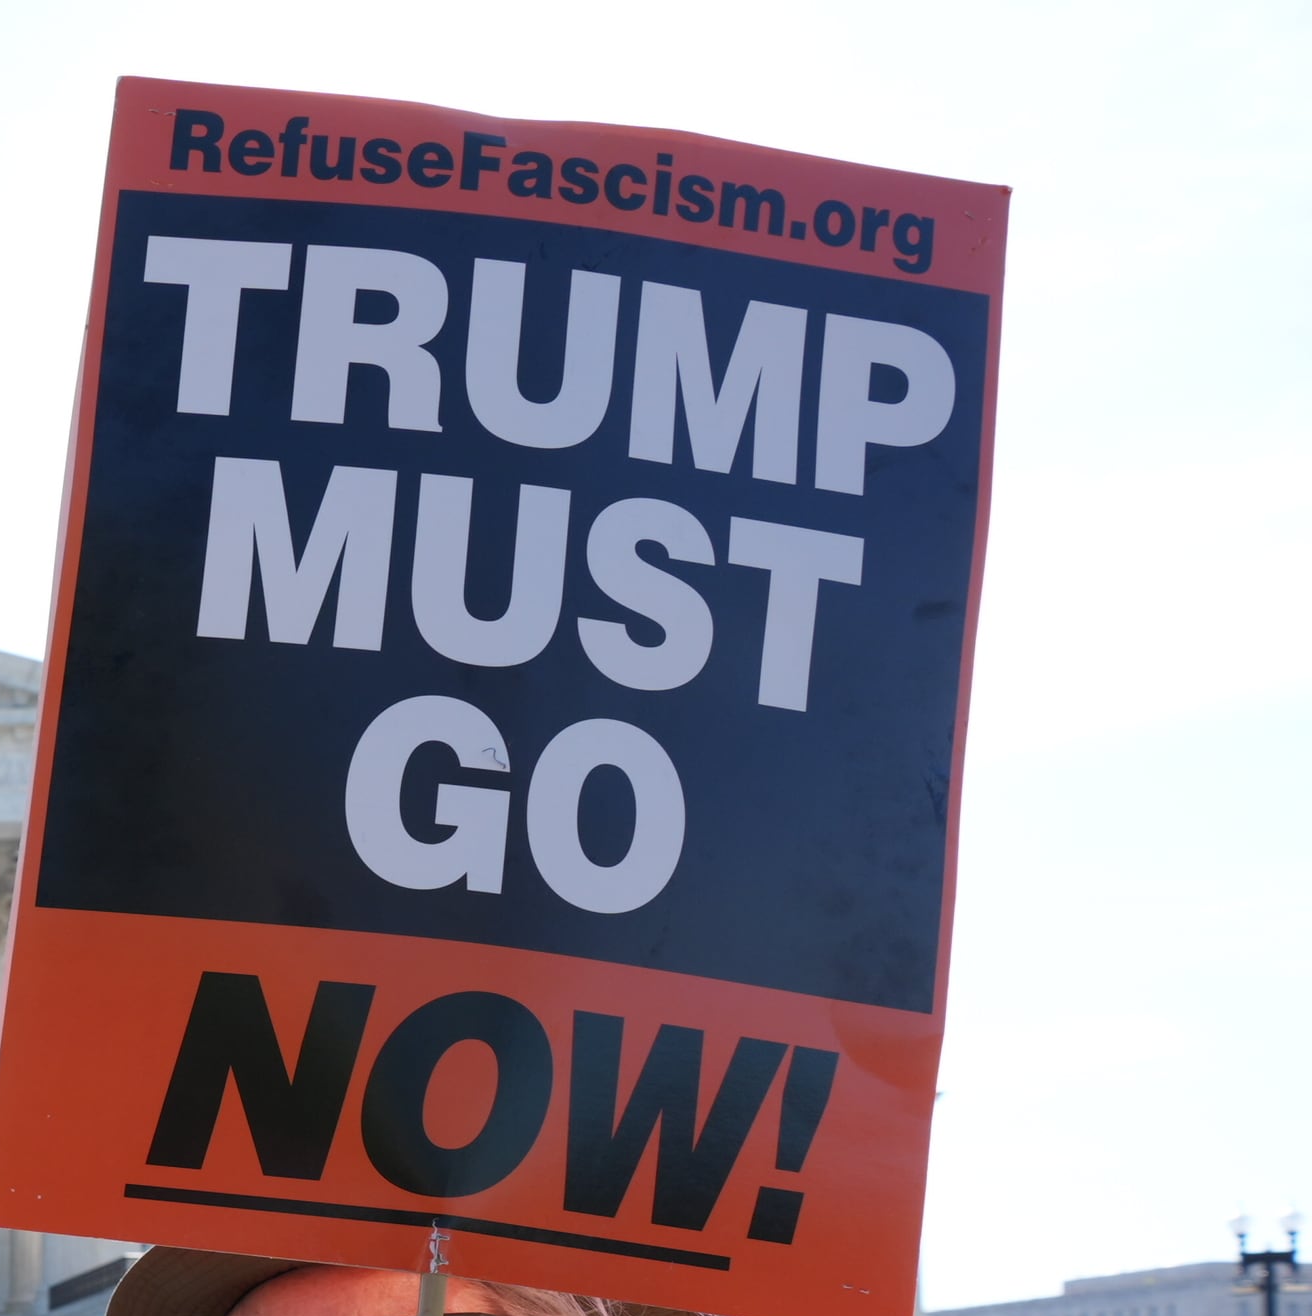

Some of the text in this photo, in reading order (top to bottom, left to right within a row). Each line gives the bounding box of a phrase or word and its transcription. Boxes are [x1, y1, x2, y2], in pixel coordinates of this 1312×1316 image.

[169, 109, 935, 274] RefuseFascism.org
[143, 235, 956, 496] TRUMP
[195, 456, 865, 713] MUST
[344, 694, 686, 915] GO
[145, 970, 840, 1247] NOW!
